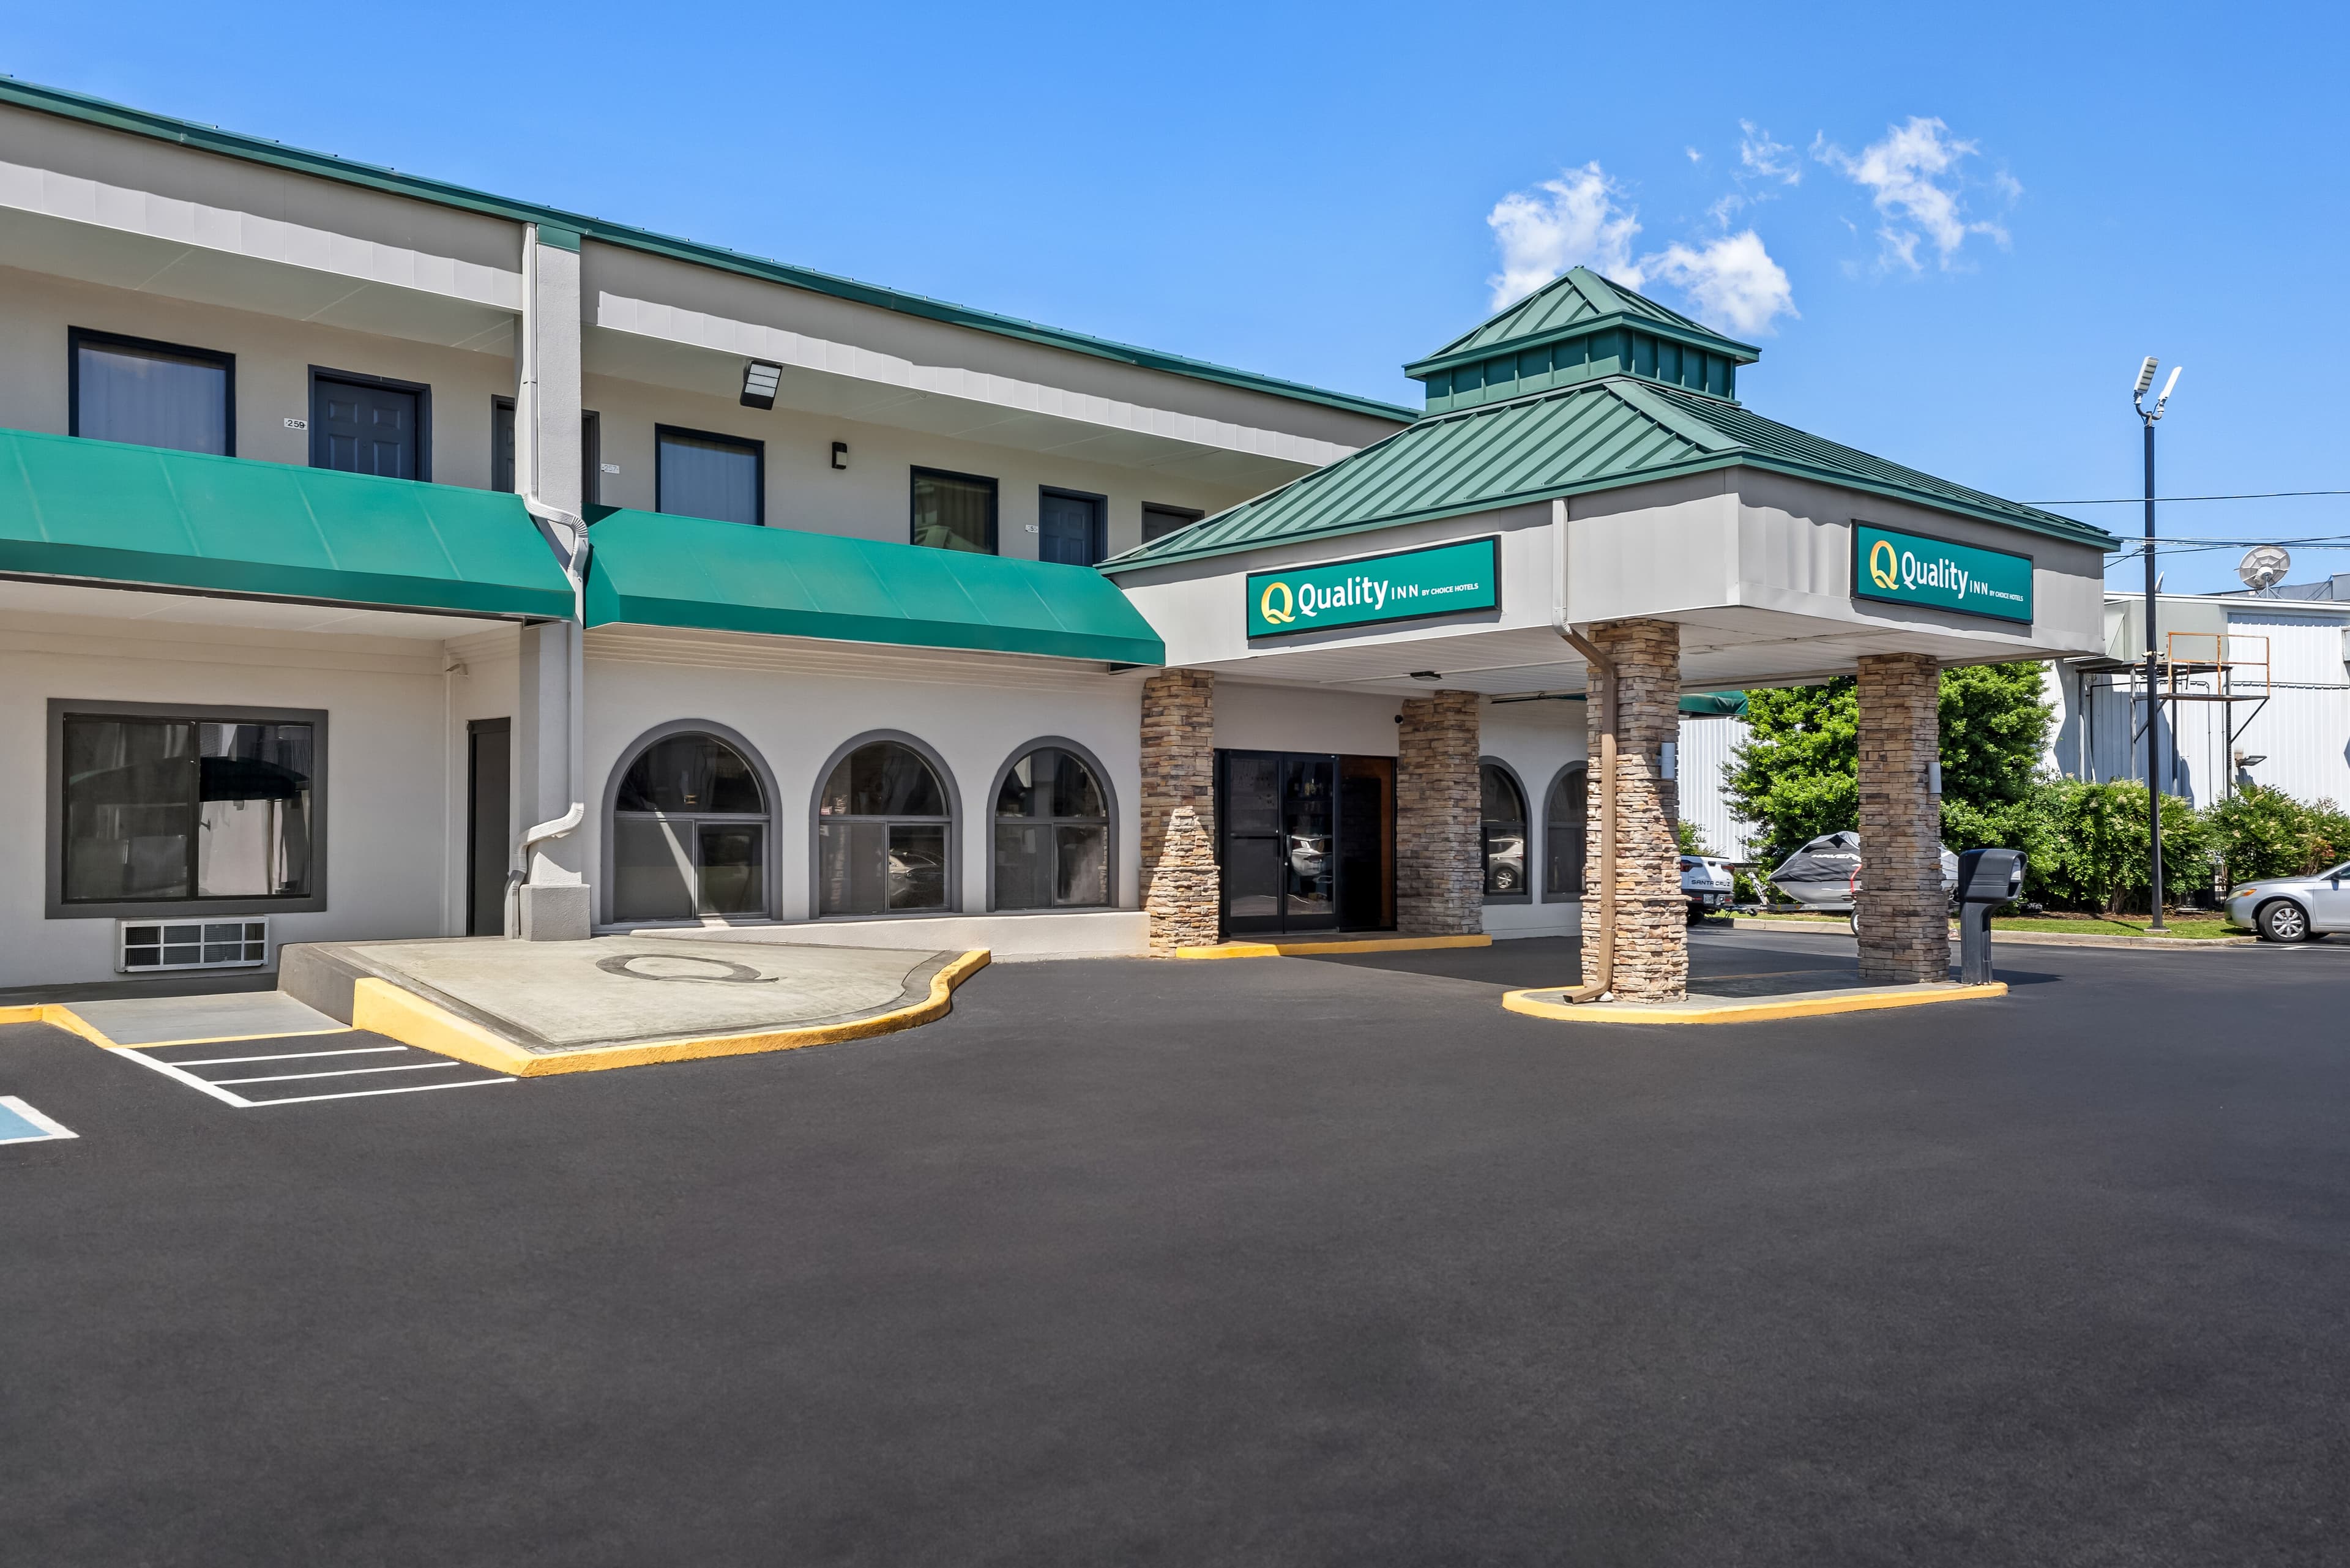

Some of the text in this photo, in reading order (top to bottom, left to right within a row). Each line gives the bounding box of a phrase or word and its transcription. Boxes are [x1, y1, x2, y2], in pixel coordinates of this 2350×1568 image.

[288, 420, 305, 429] 259
[1870, 540, 1900, 591] Q
[1901, 551, 1969, 599] Quality
[1970, 580, 1988, 595] INN
[1261, 581, 1296, 624] Q
[1298, 576, 1389, 618] Quality
[1391, 584, 1419, 600] INN
[1431, 586, 1454, 595] CHOICE
[1454, 583, 1479, 592] HOTELS
